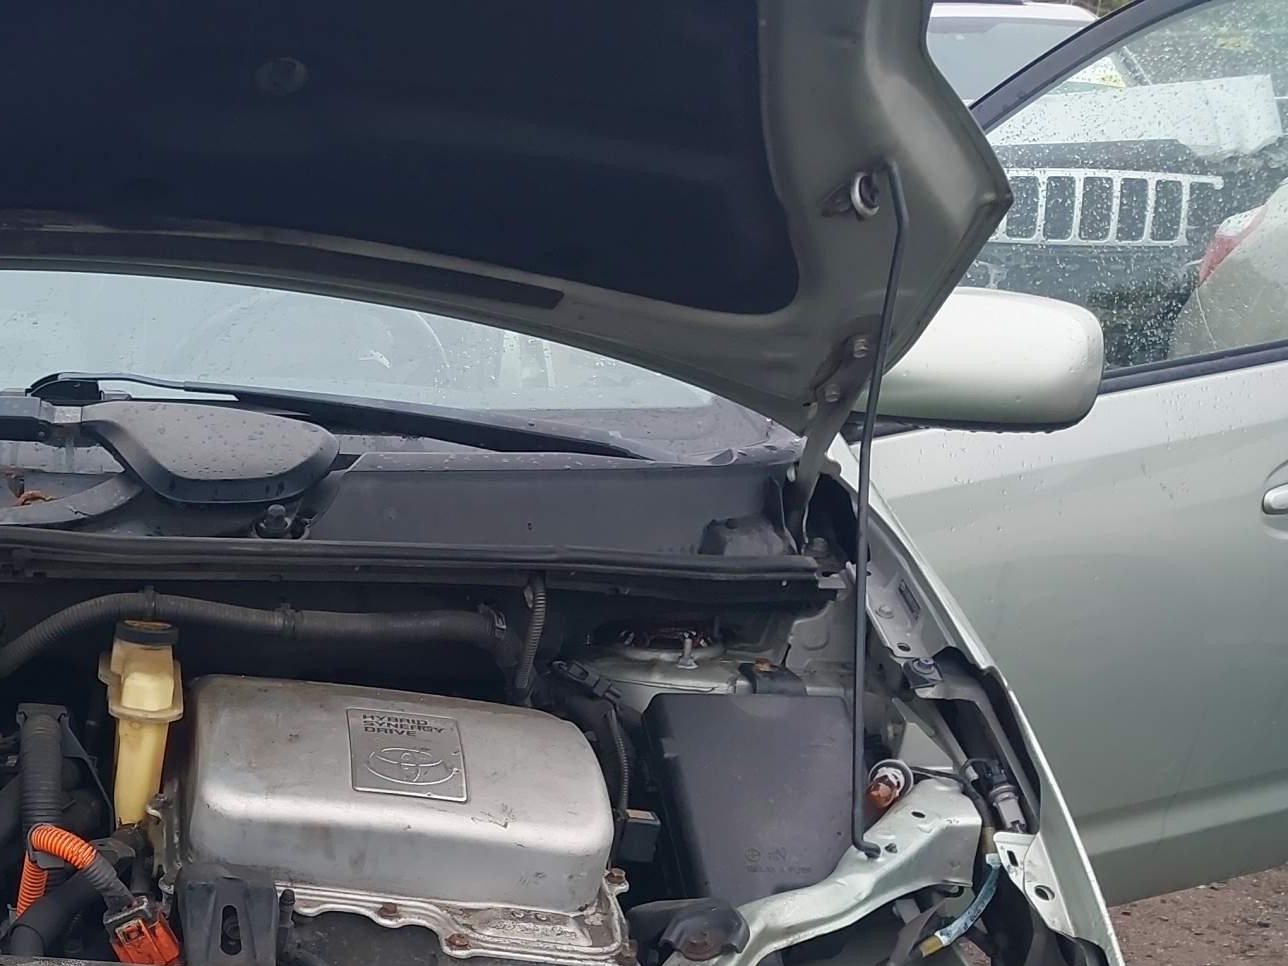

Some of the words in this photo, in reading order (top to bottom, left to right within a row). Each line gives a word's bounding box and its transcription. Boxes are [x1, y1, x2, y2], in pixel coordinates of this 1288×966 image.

[363, 714, 428, 725] HYBRID
[363, 720, 445, 733] SYNERGY
[364, 726, 416, 736] DRIVE
